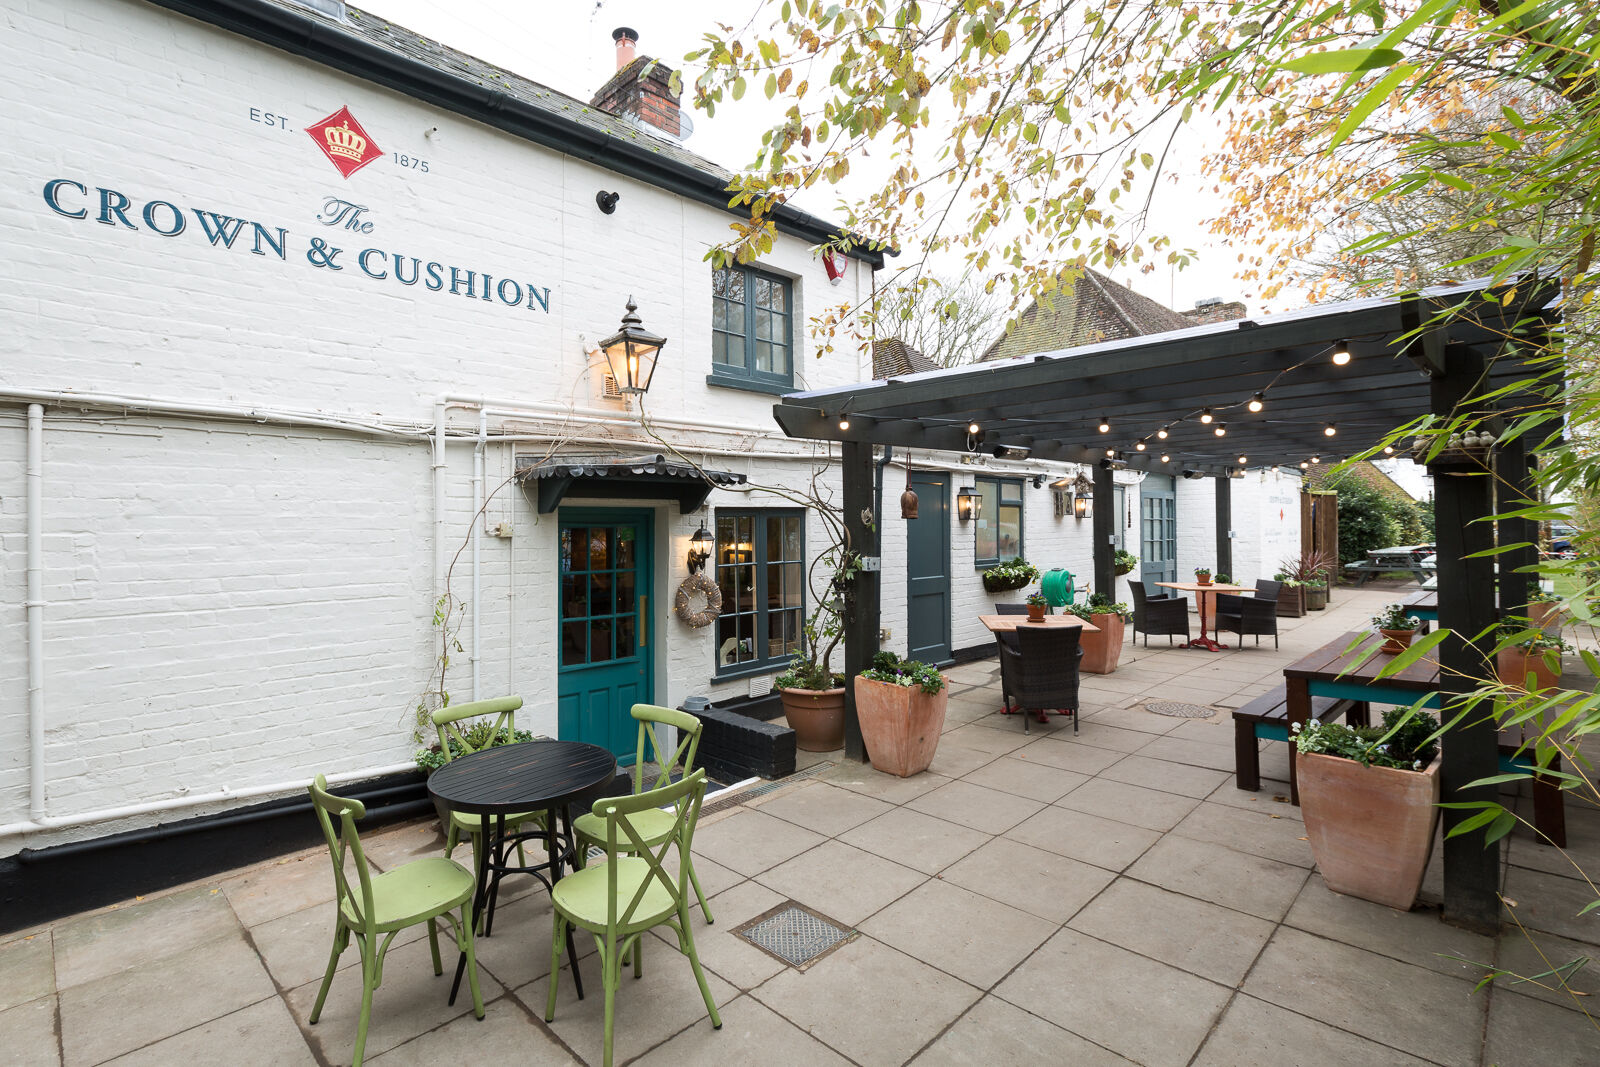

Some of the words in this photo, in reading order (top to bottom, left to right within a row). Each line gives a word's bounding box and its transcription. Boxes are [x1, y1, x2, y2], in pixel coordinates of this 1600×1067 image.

[249, 107, 293, 133] EST.
[393, 152, 429, 173] 1875
[43, 178, 287, 261] CROWN
[306, 237, 344, 271] &
[358, 248, 552, 315] CUSHION
[316, 196, 374, 234] The
